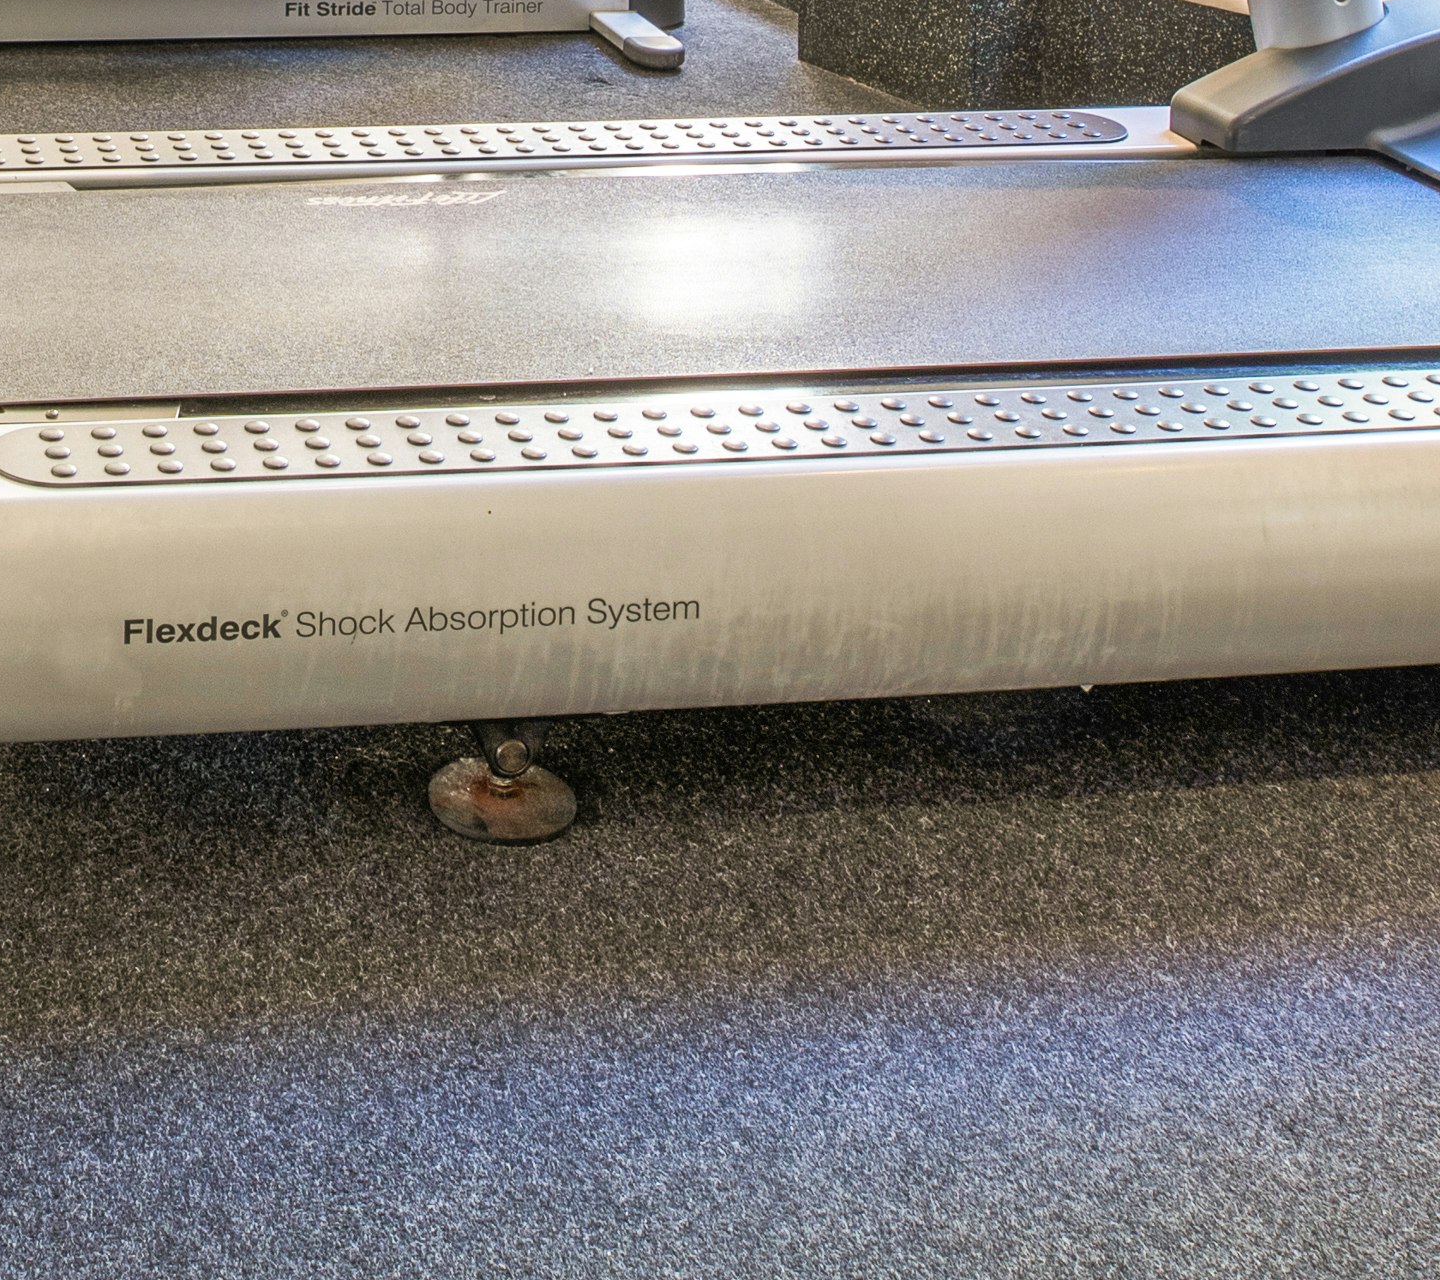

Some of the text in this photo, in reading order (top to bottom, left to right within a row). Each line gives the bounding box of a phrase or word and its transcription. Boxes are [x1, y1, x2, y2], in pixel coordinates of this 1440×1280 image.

[284, 2, 310, 17] Fit
[382, 0, 425, 16] Total
[431, 0, 478, 18] Body
[295, 607, 396, 639] Shock
[405, 600, 576, 635] Absorption
[587, 597, 701, 629] System
